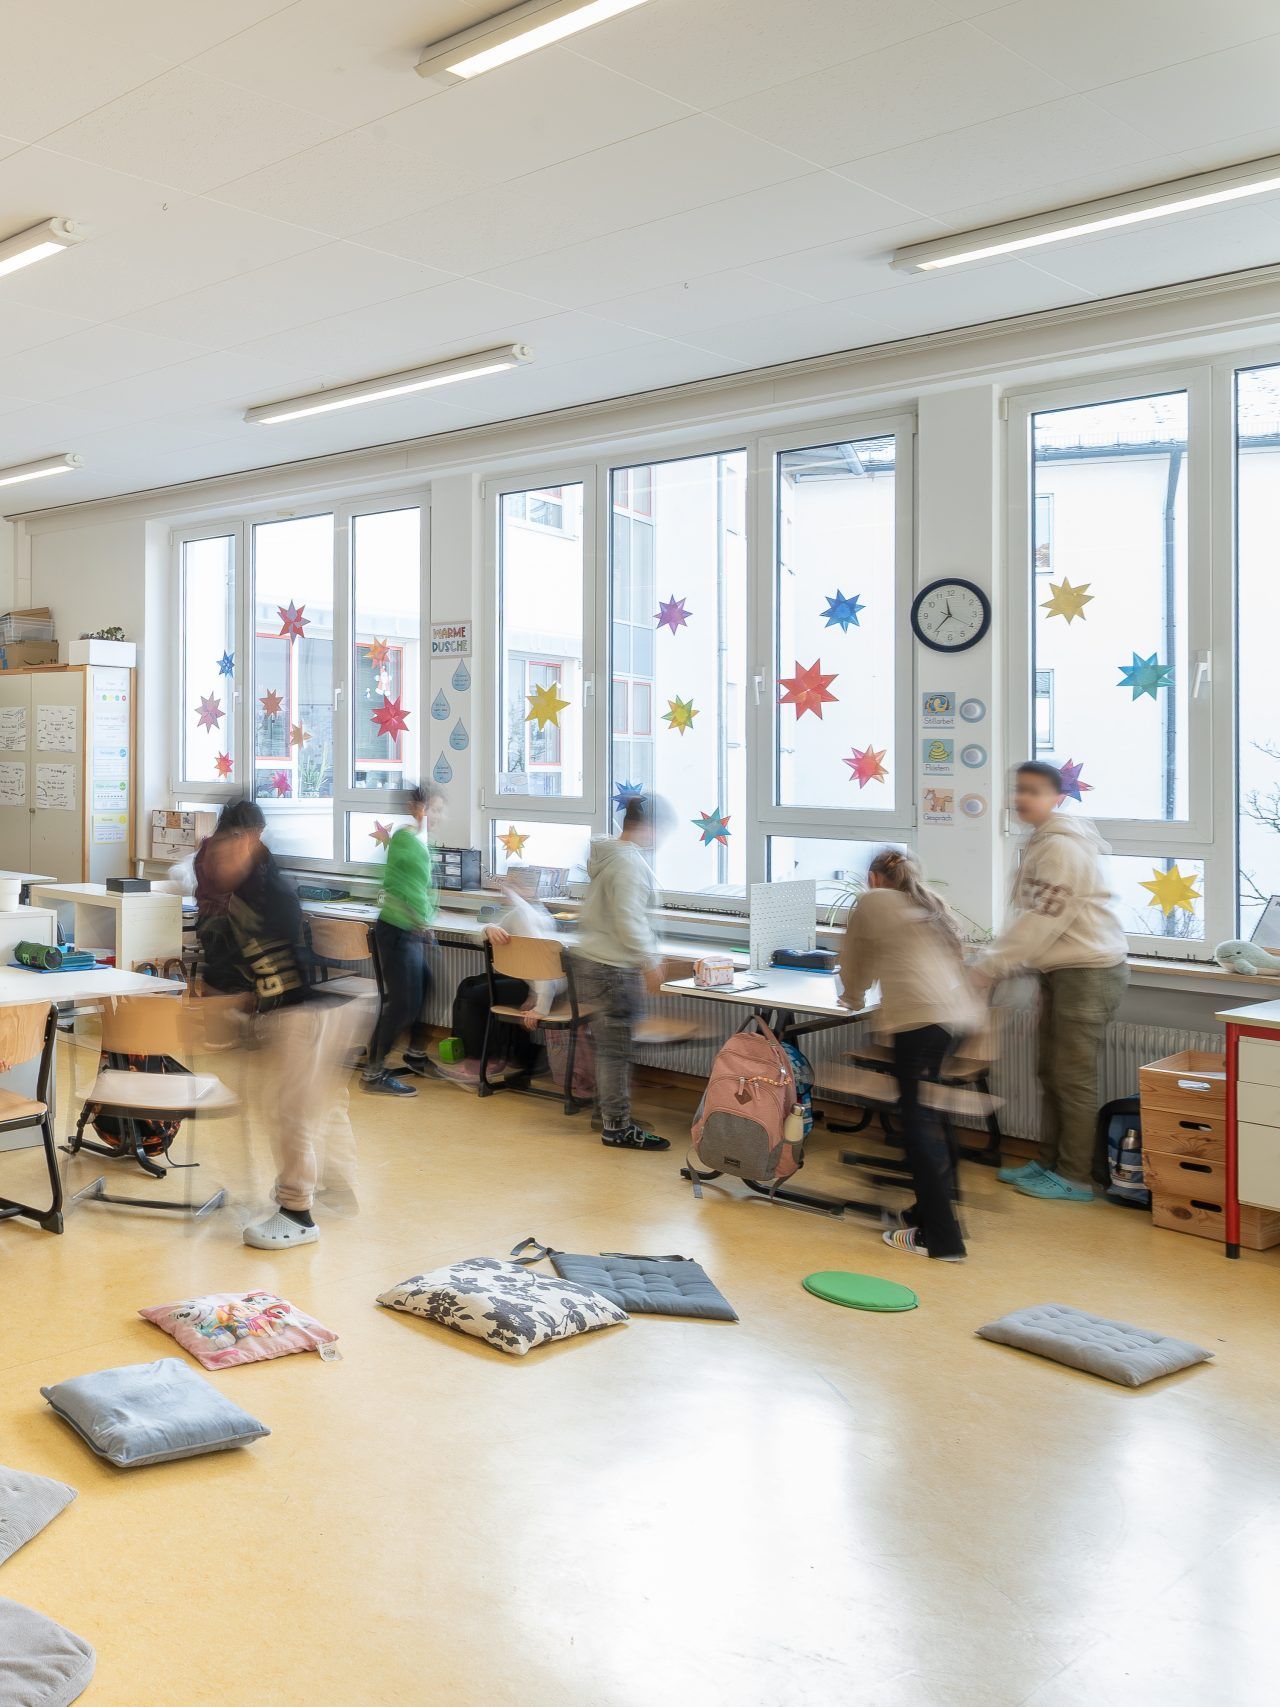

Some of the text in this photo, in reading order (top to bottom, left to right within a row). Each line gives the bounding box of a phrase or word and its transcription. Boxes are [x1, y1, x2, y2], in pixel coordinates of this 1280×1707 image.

[431, 639, 468, 653] DUSCHE
[924, 717, 954, 726] Stillarbeit
[925, 764, 950, 772] Flüstern
[923, 814, 952, 822] Gespräch
